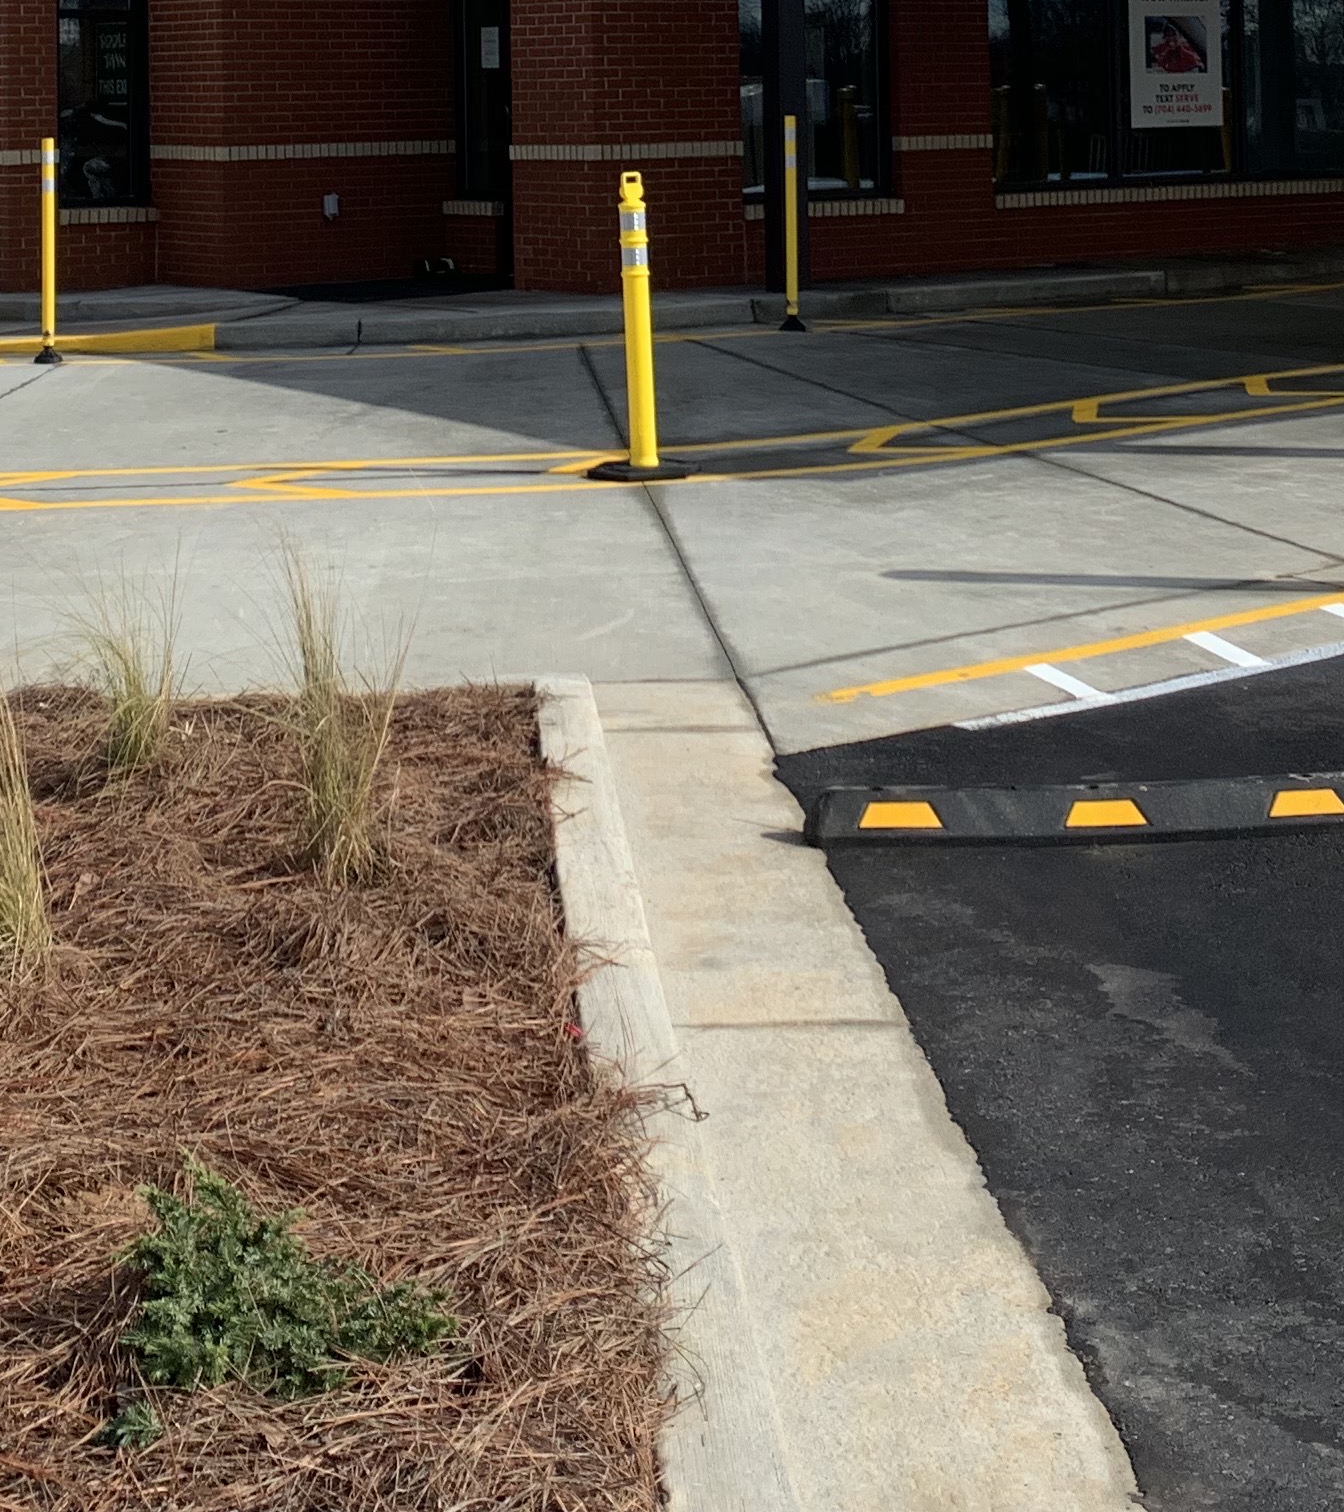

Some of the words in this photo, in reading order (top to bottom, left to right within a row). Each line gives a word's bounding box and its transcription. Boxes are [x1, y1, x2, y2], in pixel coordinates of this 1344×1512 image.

[1159, 83, 1170, 93] TO
[1171, 83, 1196, 93] APPLY
[1155, 94, 1174, 103] TEXT
[1142, 105, 1153, 114] TO
